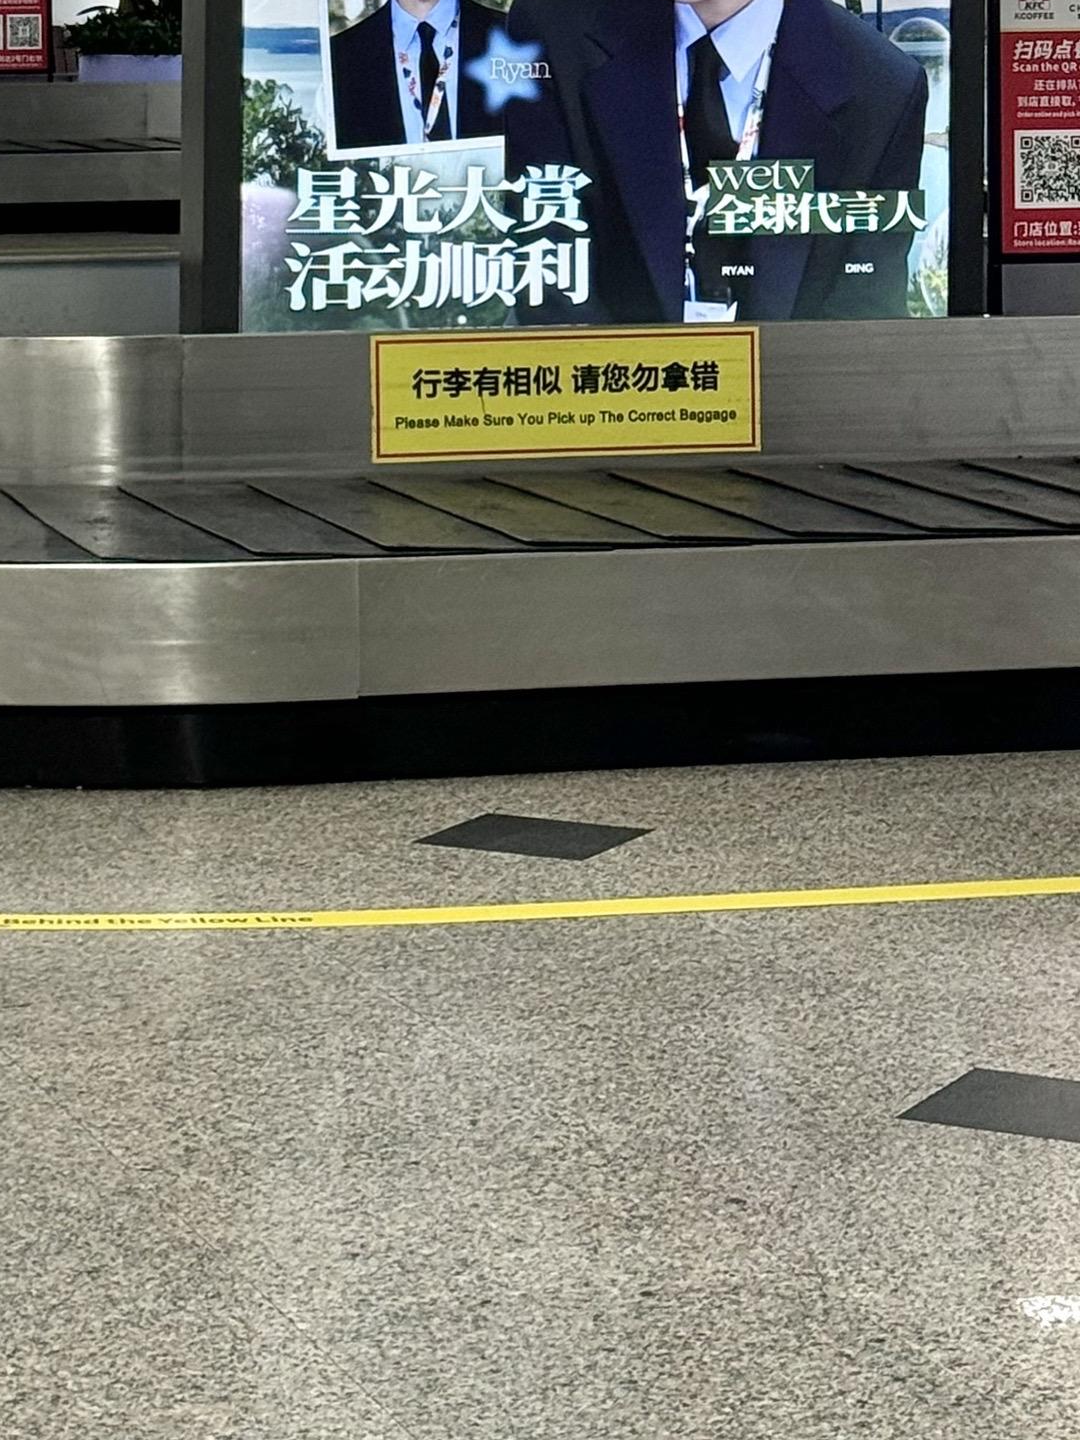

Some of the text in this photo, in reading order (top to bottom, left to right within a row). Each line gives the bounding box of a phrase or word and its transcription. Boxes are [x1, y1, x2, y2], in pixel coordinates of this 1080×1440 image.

[1014, 12, 1054, 20] KCOFFEE
[1025, 2, 1045, 10] KFC
[489, 58, 552, 84] Ryan
[1012, 62, 1077, 73] Scan the QR
[285, 164, 593, 236] 星光大赏
[706, 190, 928, 235] 全球代言人
[285, 237, 592, 311] 活动顺利
[721, 262, 875, 277] RYAN DING
[412, 361, 720, 399] 行李有相似 请您勿拿错
[395, 407, 737, 429] Please Make Sure You Pick up The Correct Baggage
[3, 916, 100, 926] Behind
[107, 916, 153, 925] the
[158, 915, 249, 925] Yellow
[255, 914, 314, 924] Line
